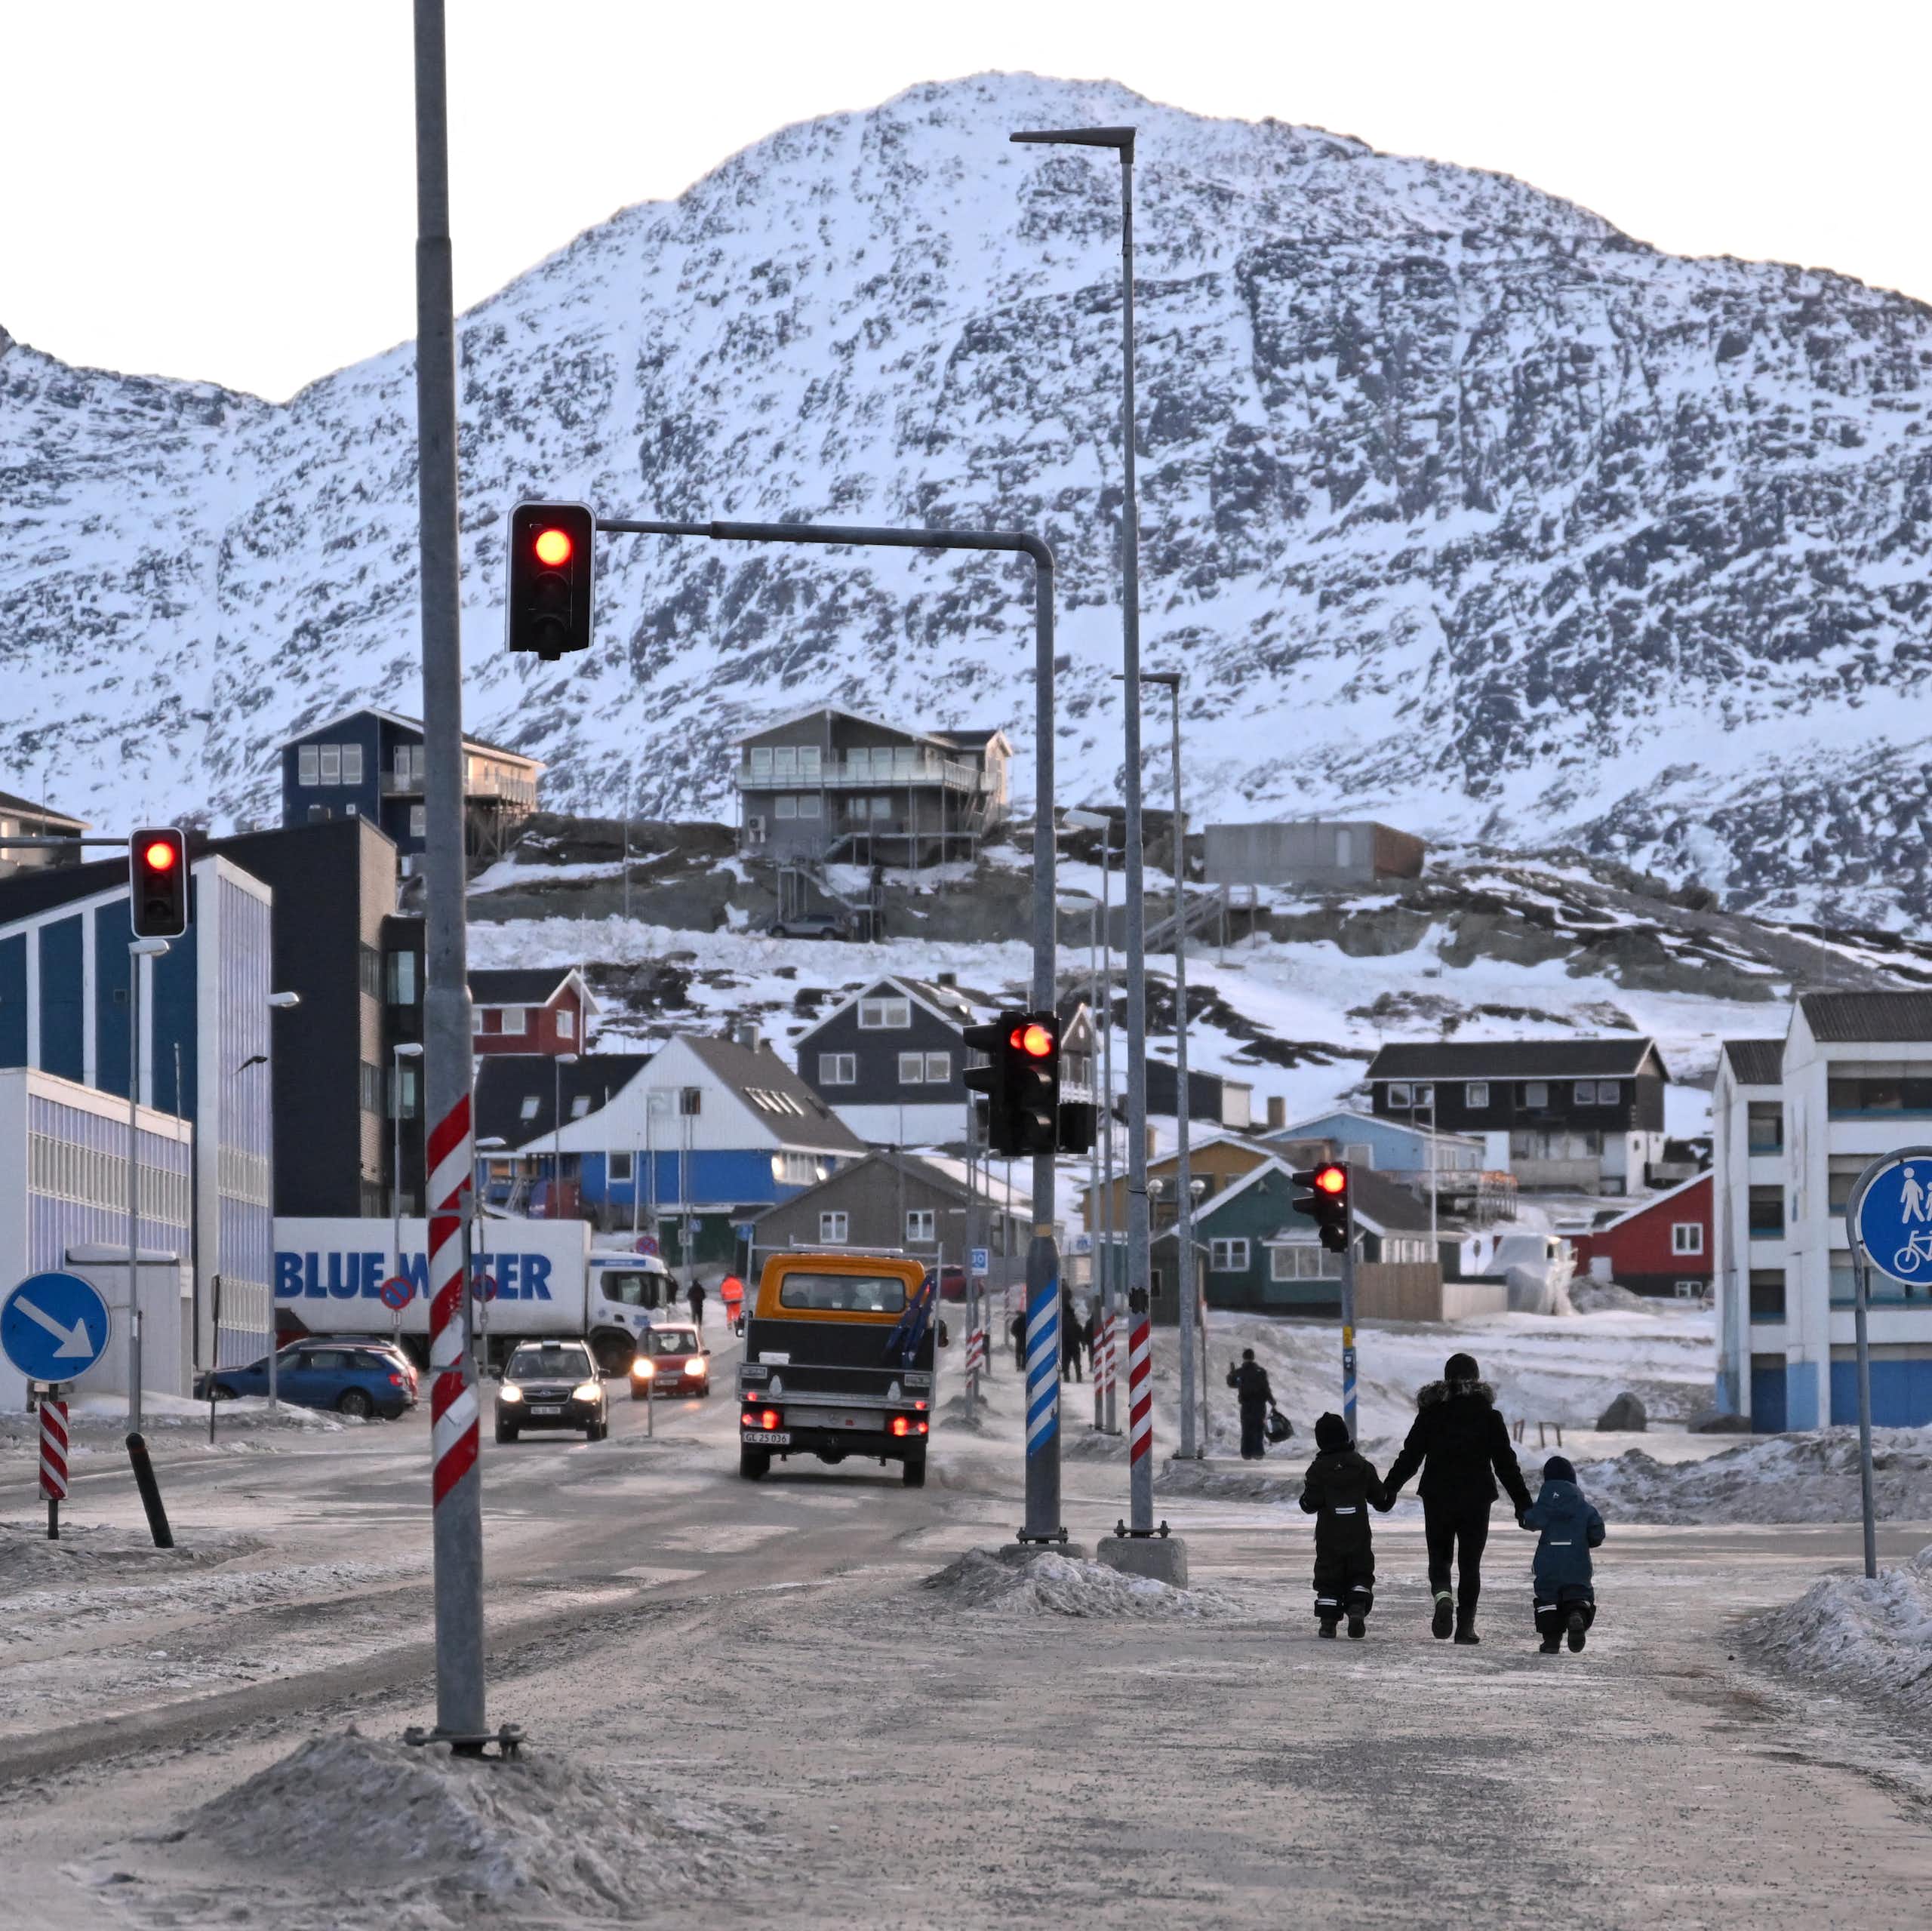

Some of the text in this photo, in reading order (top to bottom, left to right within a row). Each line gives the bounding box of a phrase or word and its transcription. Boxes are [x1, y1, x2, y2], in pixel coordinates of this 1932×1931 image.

[275, 1251, 552, 1300] BLUE WTER
[746, 1433, 786, 1443] GL 25 036
